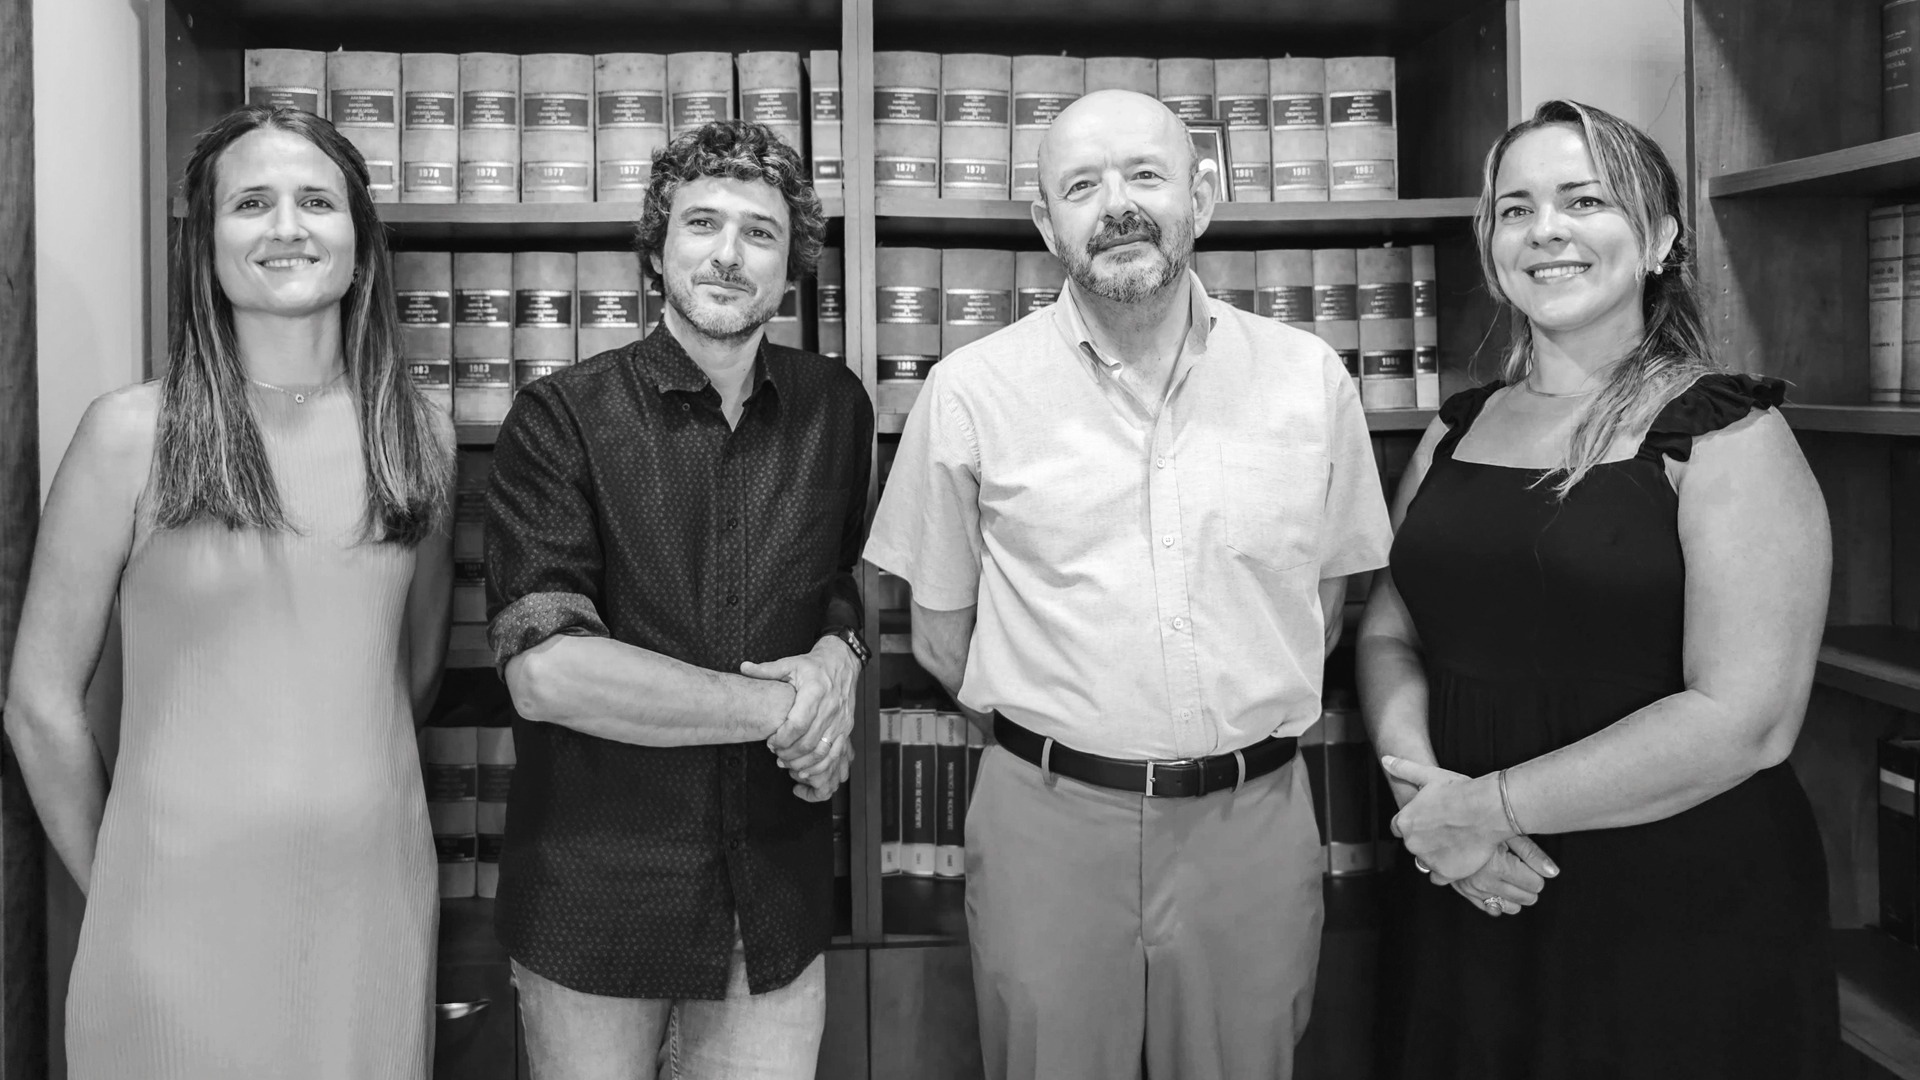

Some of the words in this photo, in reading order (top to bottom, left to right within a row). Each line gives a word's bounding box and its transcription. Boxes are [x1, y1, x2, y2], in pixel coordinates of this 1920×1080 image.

[620, 166, 640, 175] 1977
[895, 163, 916, 172] 1979
[1292, 167, 1311, 176] 1981
[544, 168, 564, 177] 1977
[469, 364, 489, 373] 1983
